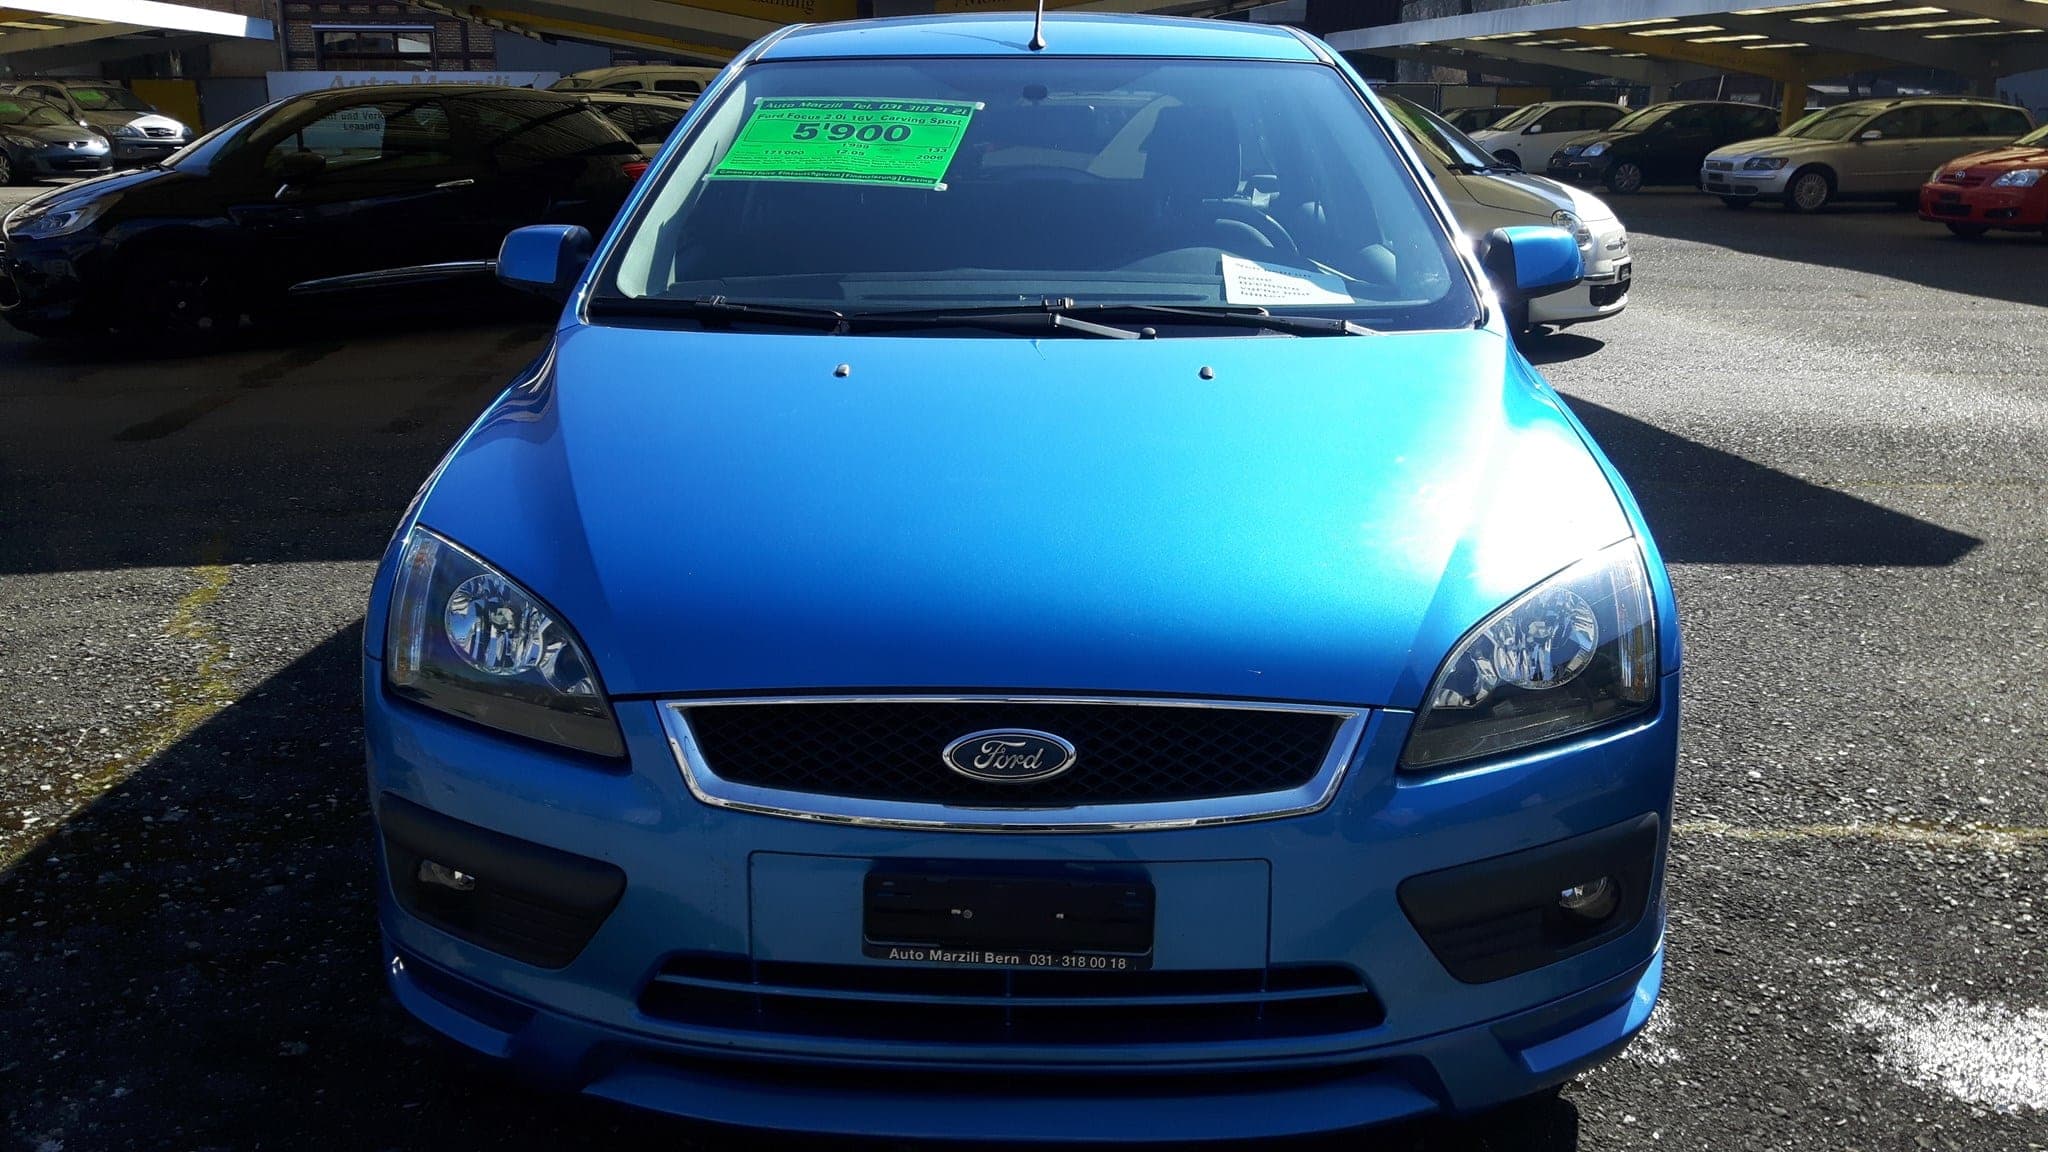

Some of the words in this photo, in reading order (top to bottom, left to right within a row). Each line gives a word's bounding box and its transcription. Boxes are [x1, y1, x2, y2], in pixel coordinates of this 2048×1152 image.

[344, 122, 380, 131] Leasing
[881, 115, 926, 124] Carving
[930, 117, 962, 125] Sport
[792, 122, 911, 142] 5'900
[973, 740, 1045, 769] Ford
[889, 948, 924, 960] Auto
[929, 949, 979, 963] Marzili
[984, 951, 1020, 964] Bern
[1089, 956, 1106, 968] 00
[1110, 957, 1126, 969] 18
